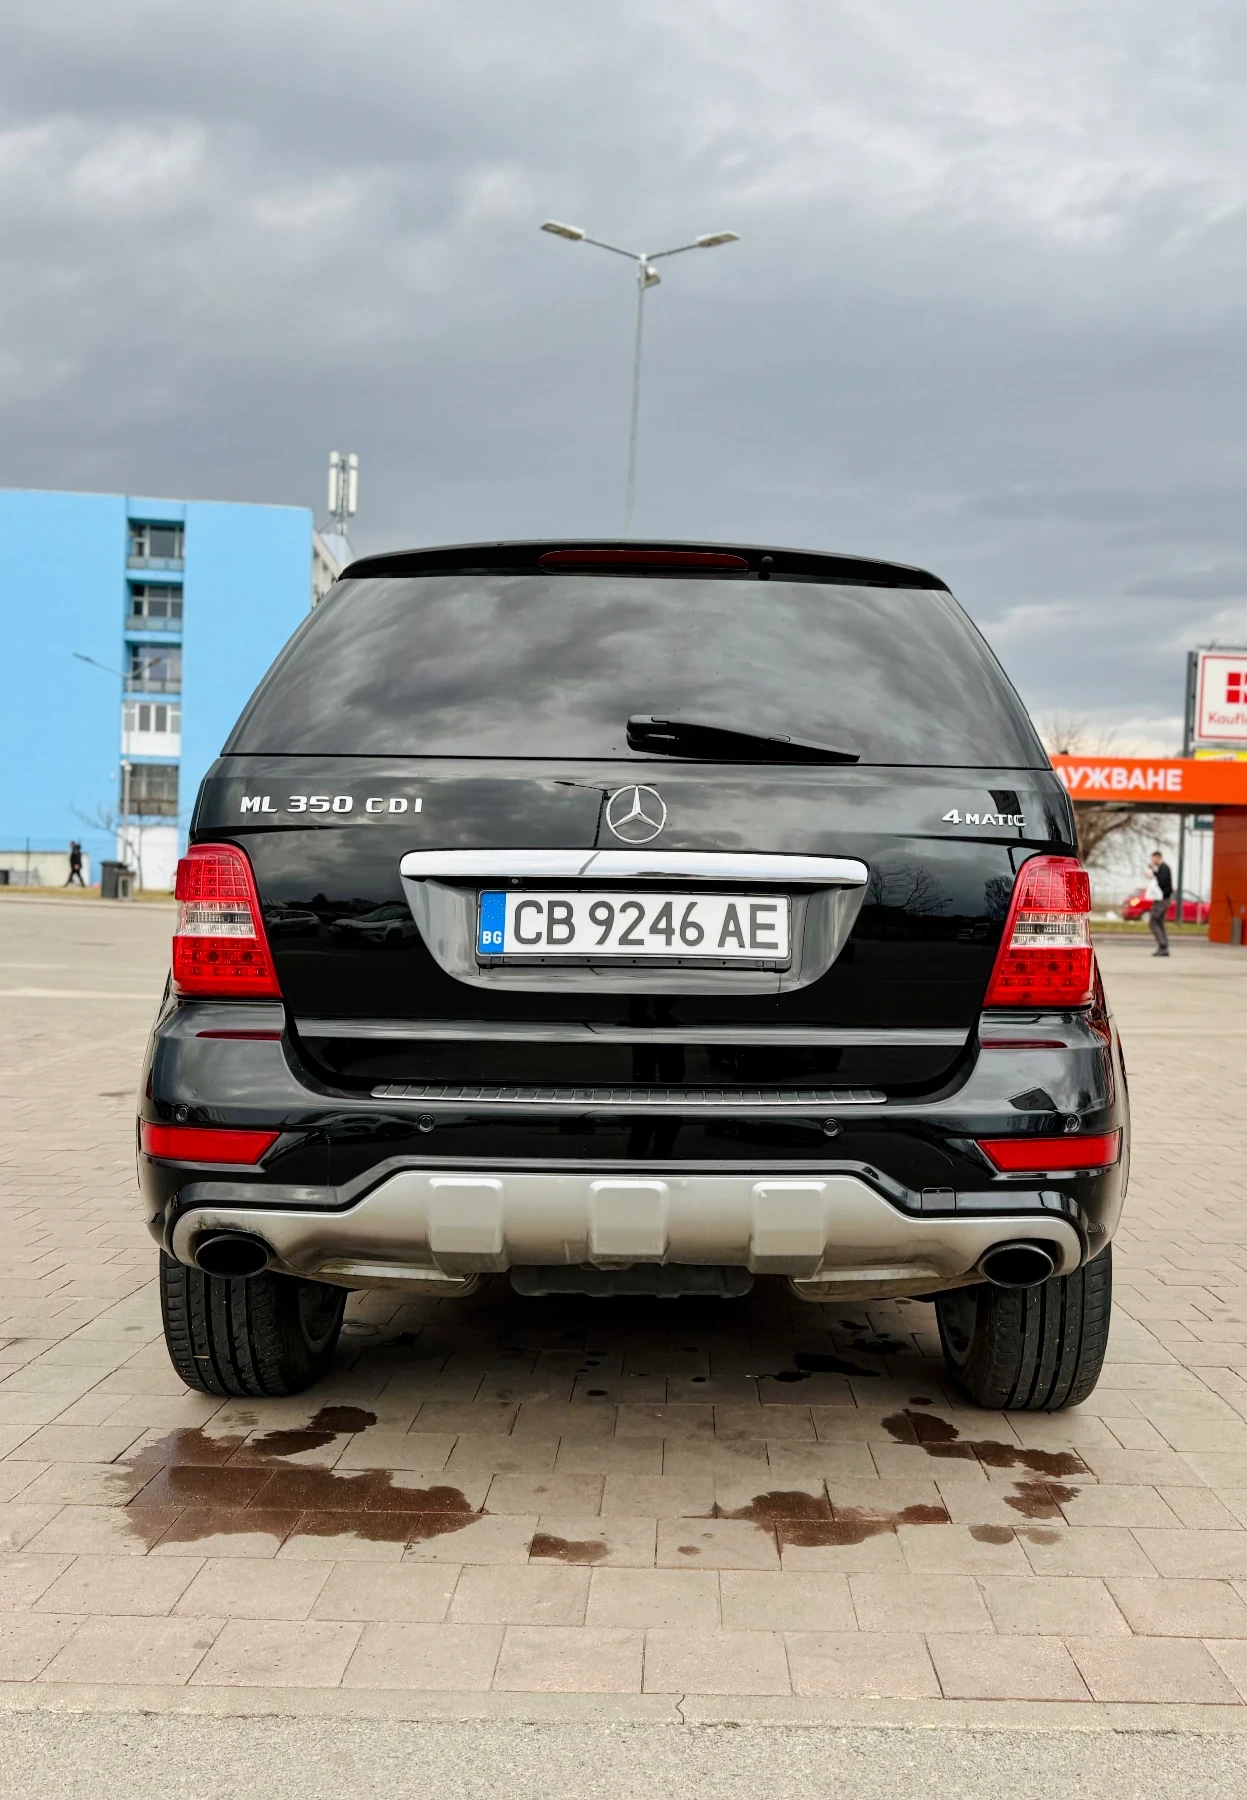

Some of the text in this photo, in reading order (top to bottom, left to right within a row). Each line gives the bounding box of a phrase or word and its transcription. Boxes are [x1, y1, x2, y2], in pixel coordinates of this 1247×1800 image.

[240, 796, 423, 813] ML 350 CDI
[513, 900, 779, 949] CB 9246 AE
[482, 930, 502, 944] BG
